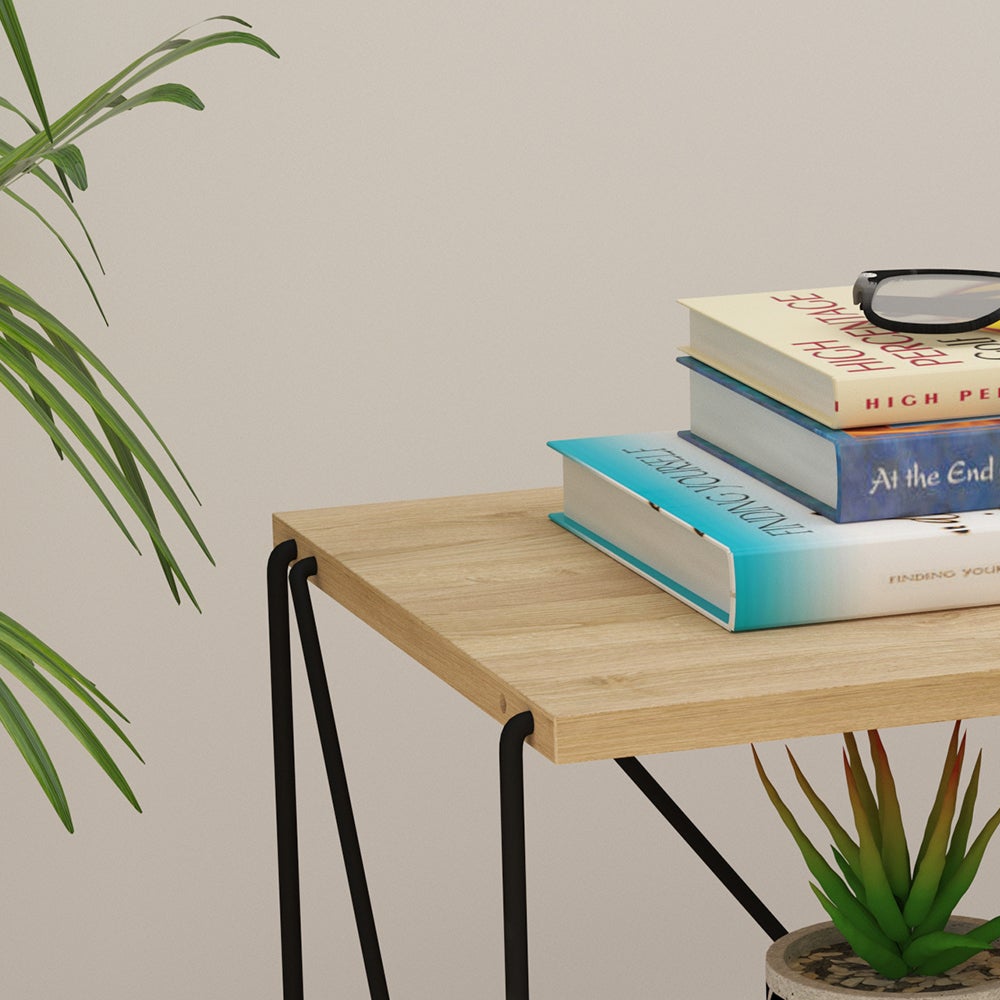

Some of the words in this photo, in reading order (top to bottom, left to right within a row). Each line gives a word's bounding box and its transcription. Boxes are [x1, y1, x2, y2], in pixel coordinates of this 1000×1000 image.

[770, 292, 964, 367] PERCENTAGE
[791, 340, 897, 373] HIGH
[865, 392, 938, 410] HIGH
[621, 447, 743, 493] YOURSELF
[868, 466, 899, 495] At
[905, 462, 941, 489] the
[947, 455, 995, 485] End
[705, 492, 814, 537] FINDING
[889, 569, 957, 584] FINDING
